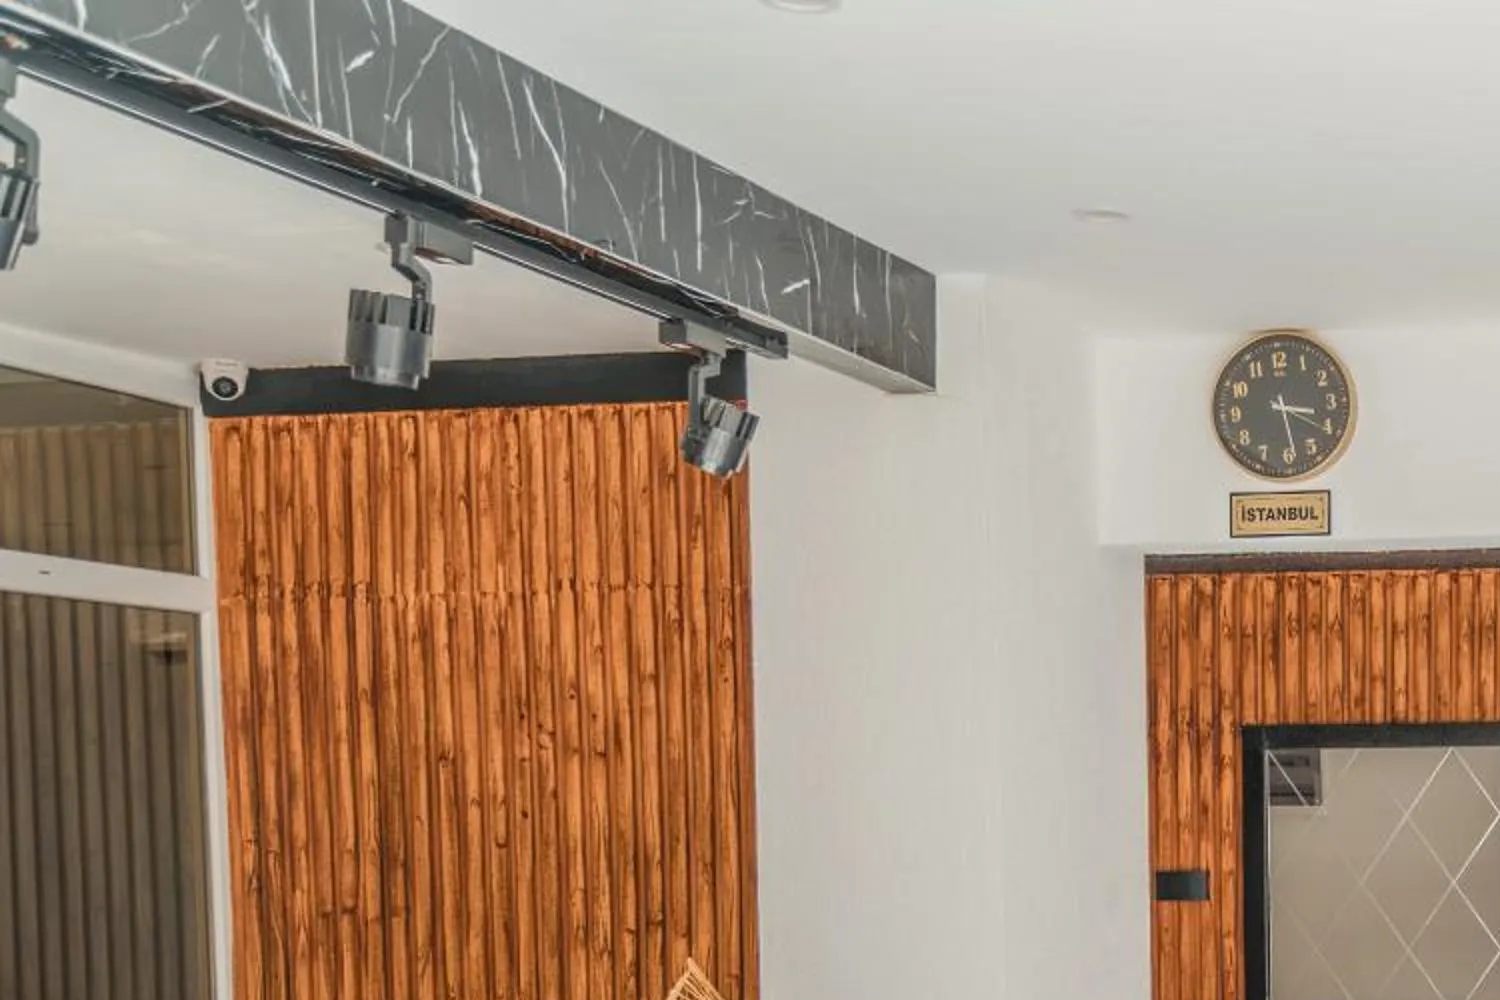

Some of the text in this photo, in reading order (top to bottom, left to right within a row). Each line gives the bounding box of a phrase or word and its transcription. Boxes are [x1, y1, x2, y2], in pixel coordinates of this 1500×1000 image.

[1272, 351, 1287, 368] 12
[1299, 355, 1307, 370] 1
[1250, 361, 1263, 378] 11
[1316, 371, 1328, 387] 2
[1233, 381, 1248, 398] 10
[1326, 394, 1336, 410] 3
[1231, 407, 1241, 423] 9
[1322, 420, 1333, 435] 4
[1239, 430, 1250, 445] 8
[1258, 445, 1268, 461] 7
[1305, 438, 1316, 454] 5
[1283, 450, 1296, 464] 6
